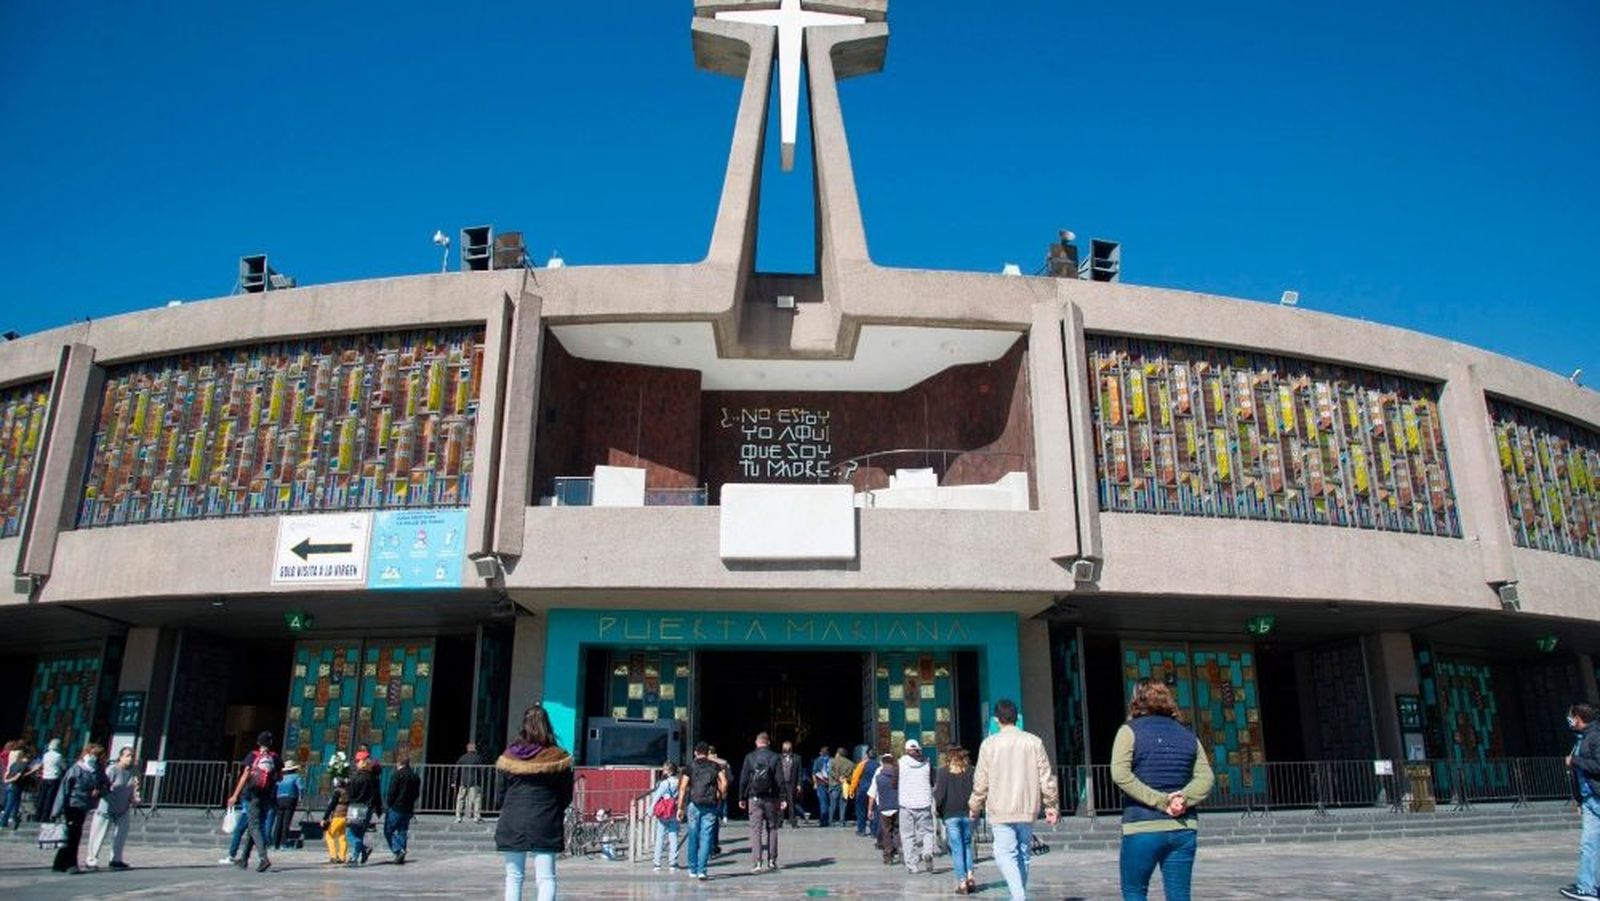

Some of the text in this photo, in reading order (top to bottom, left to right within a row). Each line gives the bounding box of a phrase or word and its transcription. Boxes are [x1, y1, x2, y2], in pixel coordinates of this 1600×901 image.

[741, 425, 830, 442] YO AQUI
[741, 443, 831, 460] QUE SOY
[739, 459, 760, 477] TU
[280, 565, 296, 577] SOLO
[297, 565, 318, 577] VISITA
[319, 565, 324, 576] A
[334, 564, 358, 577] VIRGEN
[599, 616, 970, 641] PUERTA MARIANA
